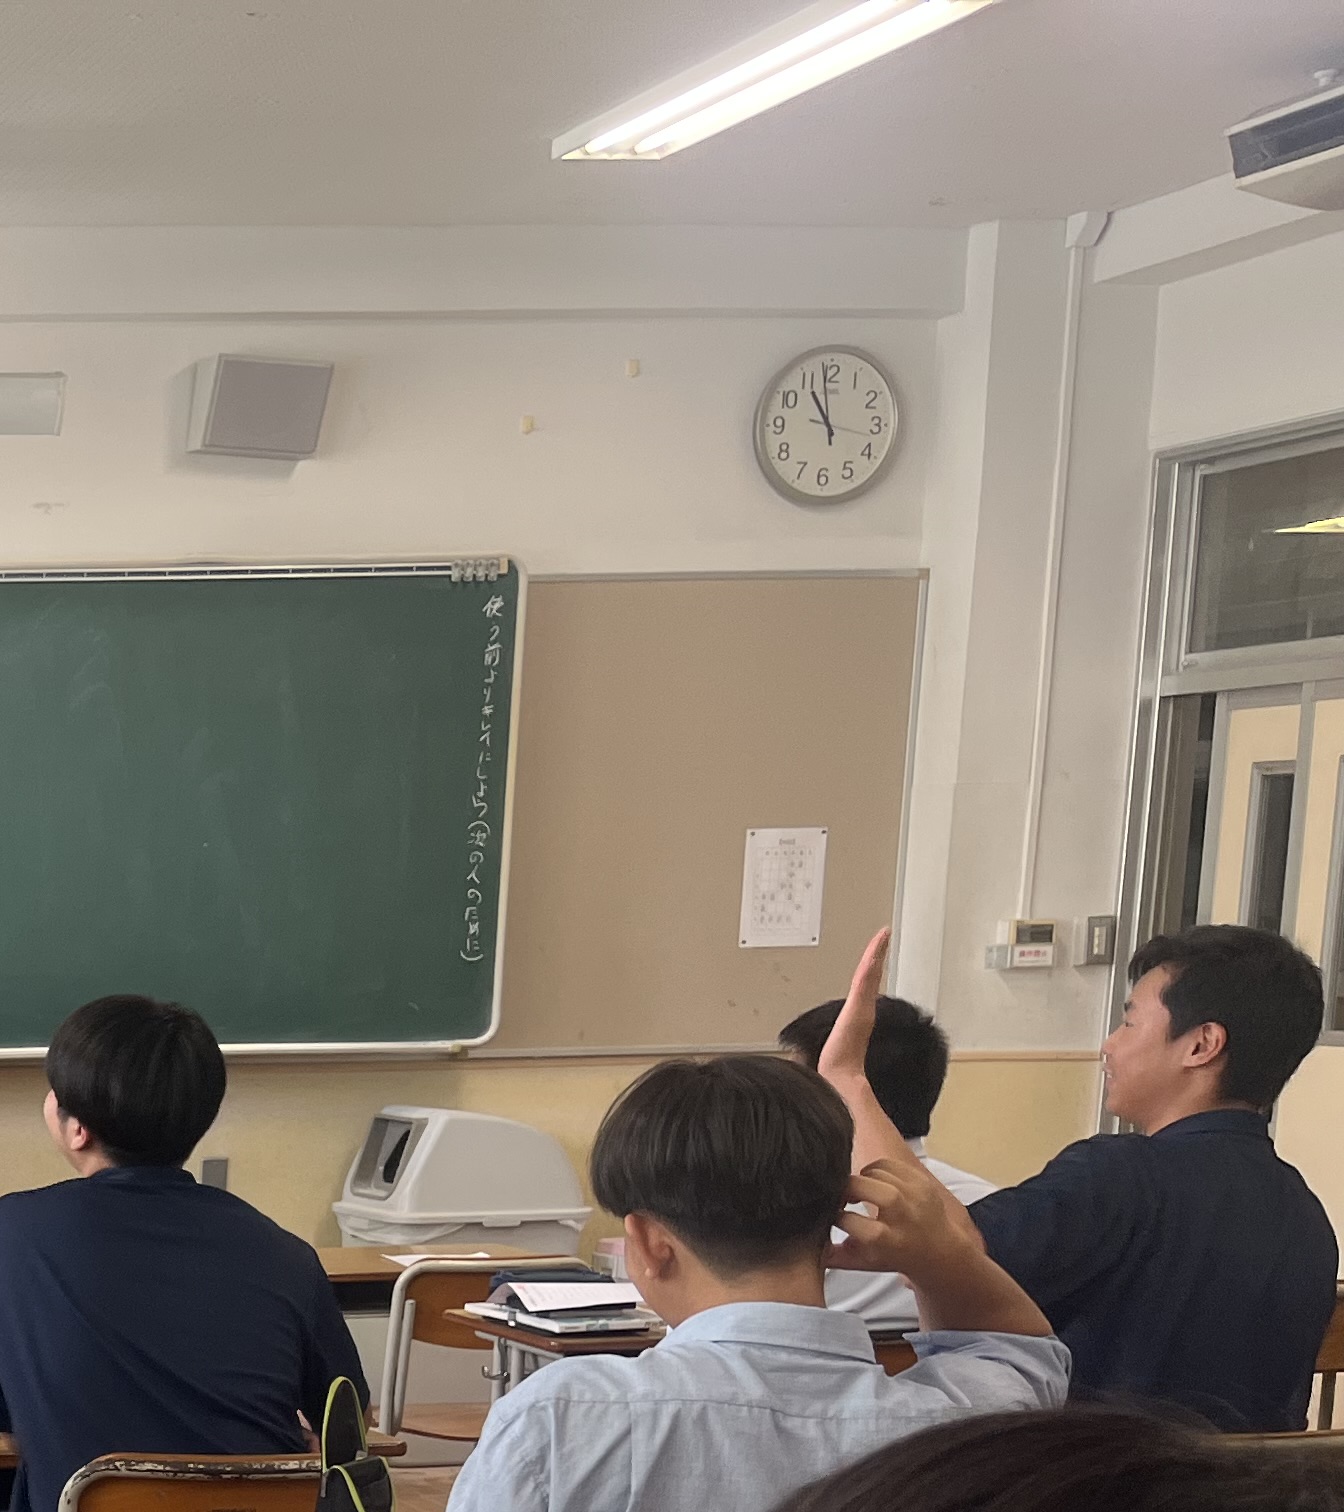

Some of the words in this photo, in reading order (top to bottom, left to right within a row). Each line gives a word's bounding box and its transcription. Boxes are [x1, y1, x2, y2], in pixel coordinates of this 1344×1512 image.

[801, 371, 814, 390] 11
[823, 363, 841, 384] 12
[852, 371, 858, 390] 1
[781, 390, 798, 409] 10
[864, 390, 879, 410] 2
[772, 415, 785, 435] 9
[869, 415, 882, 435] 3
[777, 442, 790, 461] 8
[860, 442, 872, 461] 4
[795, 461, 808, 480] 7
[816, 467, 829, 487] 6
[841, 460, 854, 480] 5
